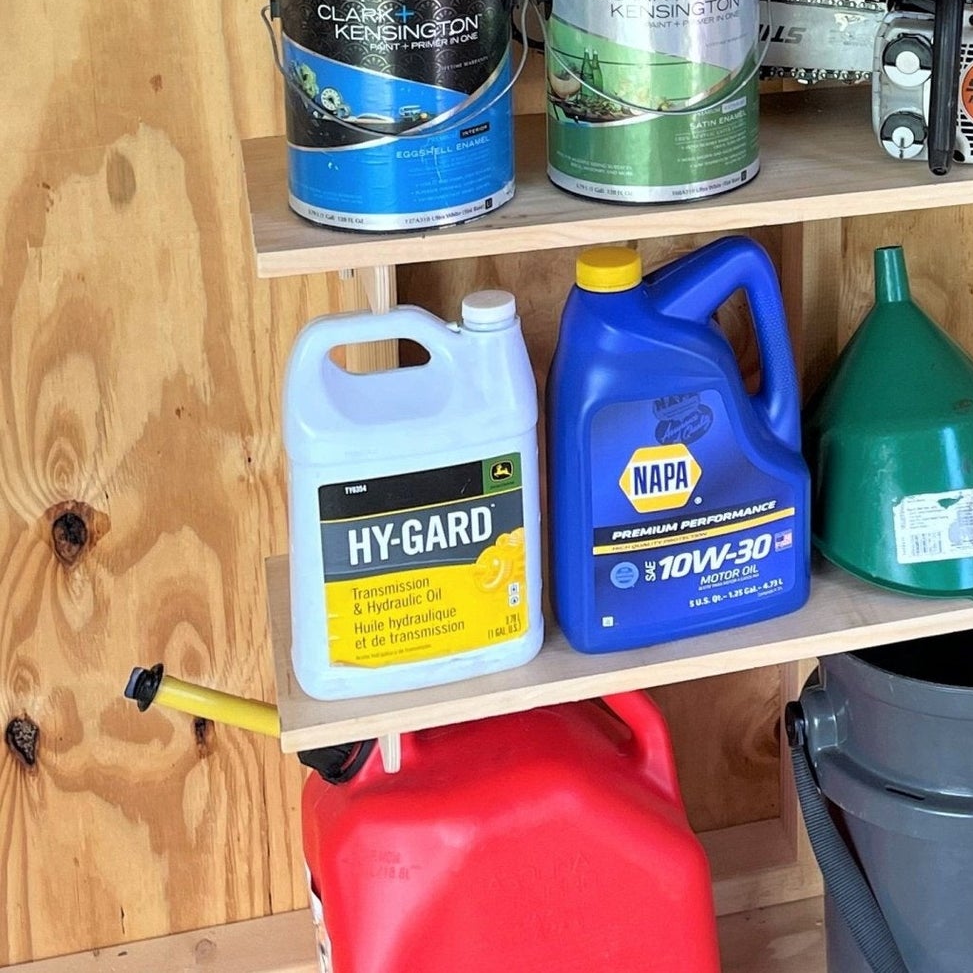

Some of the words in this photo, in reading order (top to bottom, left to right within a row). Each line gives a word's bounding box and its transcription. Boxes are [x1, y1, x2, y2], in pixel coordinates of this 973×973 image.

[335, 14, 480, 41] KENSINGTON
[369, 41, 400, 51] PAINT
[411, 39, 448, 51] PRIMER
[450, 35, 460, 45] IN
[461, 31, 479, 43] ONE
[462, 124, 488, 136] INTERIOR
[690, 119, 717, 129] SATIN
[719, 110, 747, 124] ENAMEL
[396, 146, 453, 159] EGGSHELL
[456, 135, 490, 151] ENAMEL
[634, 460, 688, 496] NAPA
[612, 521, 678, 541] PREMIUM
[681, 501, 777, 530] PERFORMANCE
[348, 506, 493, 567] HY-GARD
[645, 560, 656, 582] SAE
[658, 533, 773, 581] 10W-30
[700, 568, 740, 586] MOTOR
[742, 564, 759, 576] OIL
[352, 577, 430, 601] Transmission
[353, 604, 363, 616] &
[367, 592, 423, 617] Hydraulic
[426, 588, 442, 602] Oil
[695, 596, 711, 606] U.S.
[354, 619, 385, 635] Huile
[388, 606, 457, 630] hydraulique
[355, 639, 367, 650] et
[371, 633, 386, 647] de
[390, 620, 465, 644] transmission
